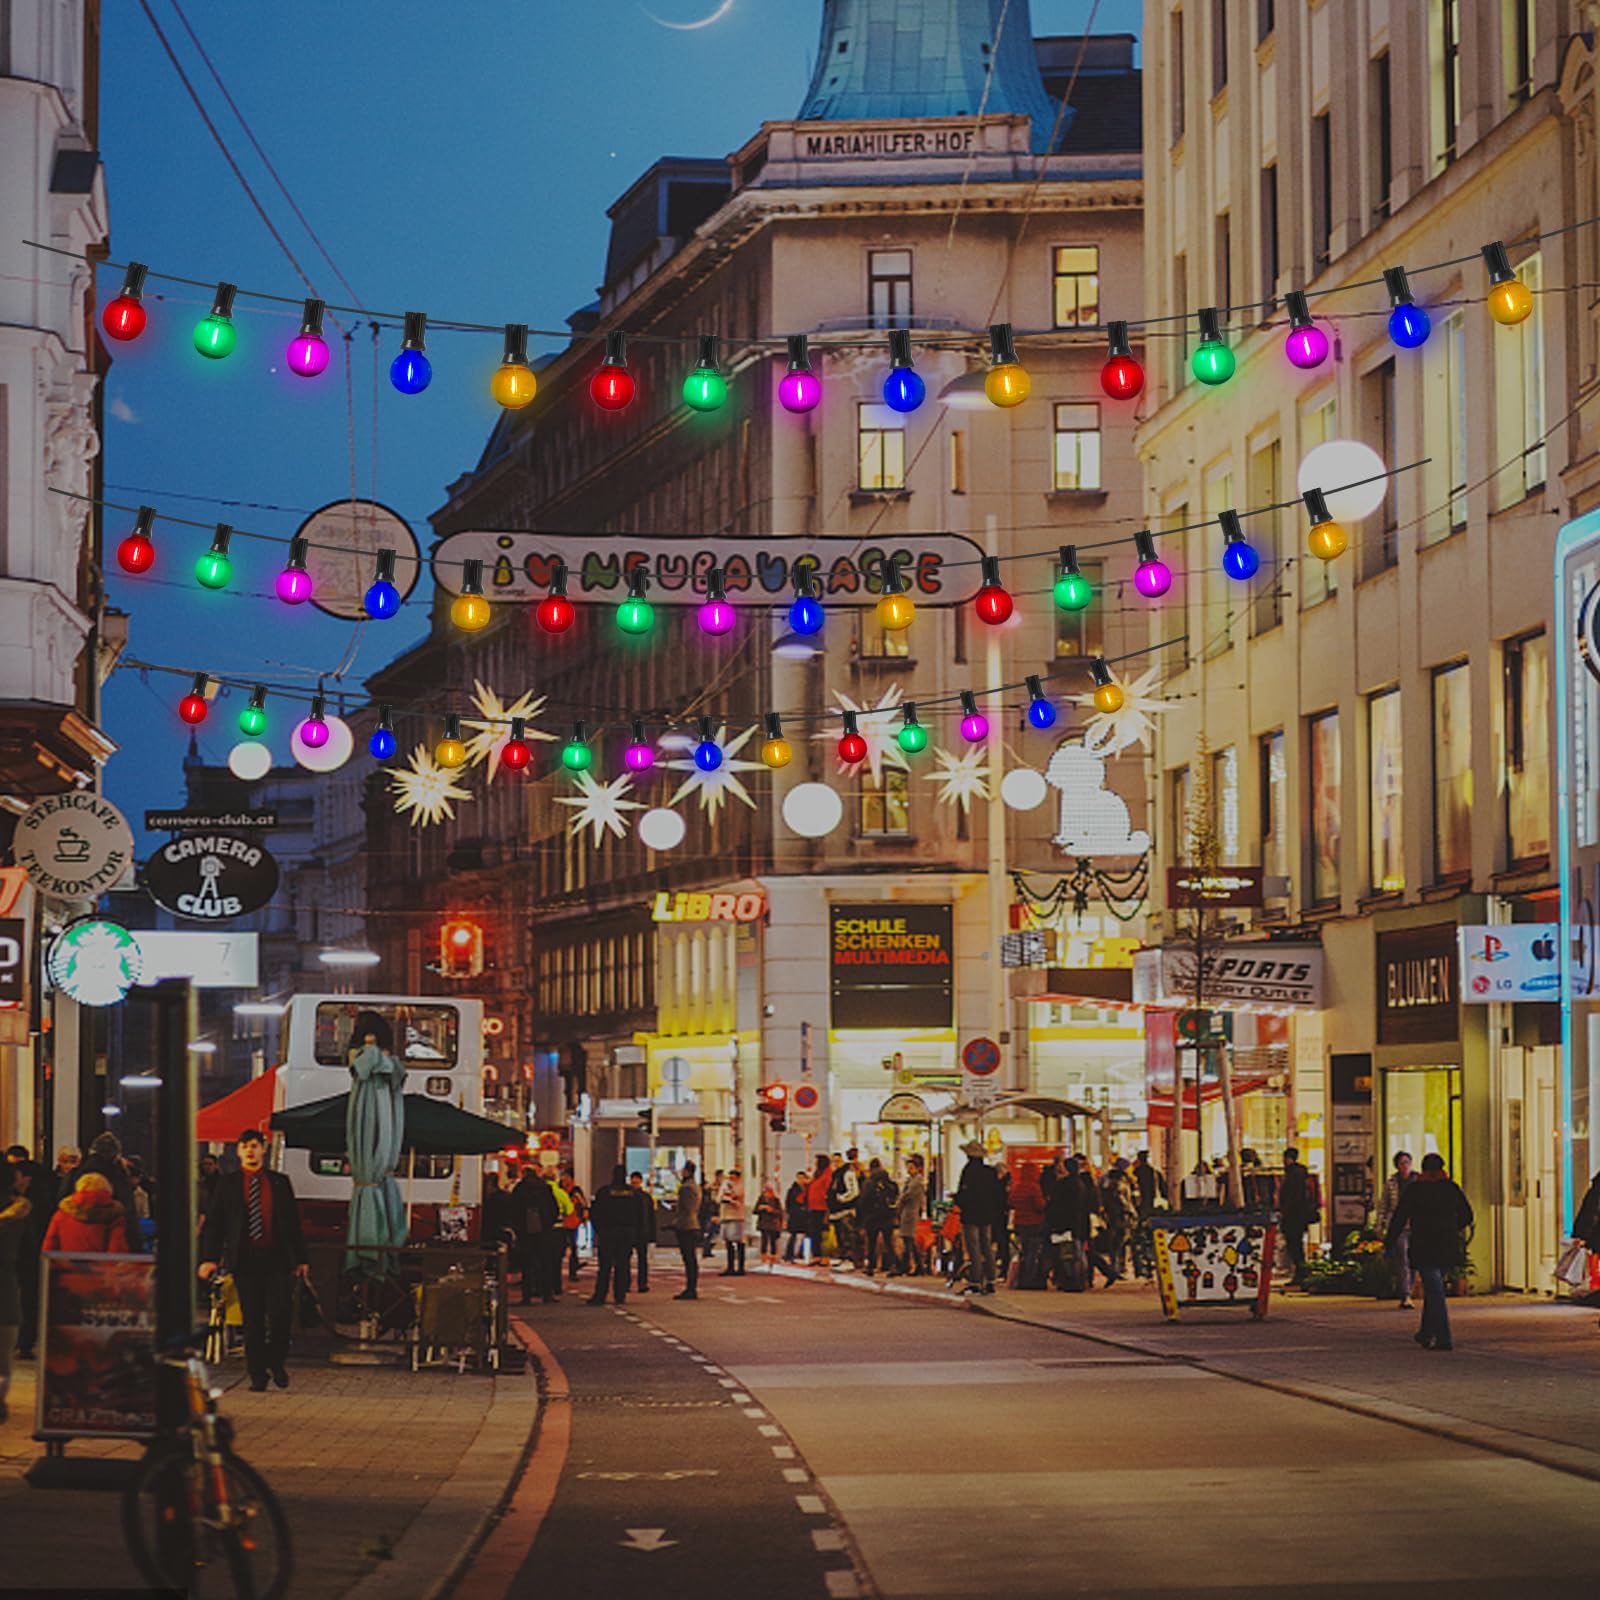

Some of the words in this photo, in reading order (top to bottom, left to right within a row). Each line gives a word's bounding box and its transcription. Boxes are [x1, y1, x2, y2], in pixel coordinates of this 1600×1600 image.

[807, 131, 974, 154] MARIAHILFER-HOF
[148, 813, 275, 827] camera-club.at
[164, 836, 262, 867] CAMERA
[21, 849, 124, 894] TEEKONTOR
[177, 893, 243, 917] CLUB
[834, 919, 907, 934] SCHULE
[834, 934, 940, 950] SCHENKEN
[834, 951, 950, 965] MULTIMEDIA
[1202, 957, 1311, 982] SPORTS
[1387, 956, 1449, 1007] BLUMEN
[1496, 979, 1512, 990] LG
